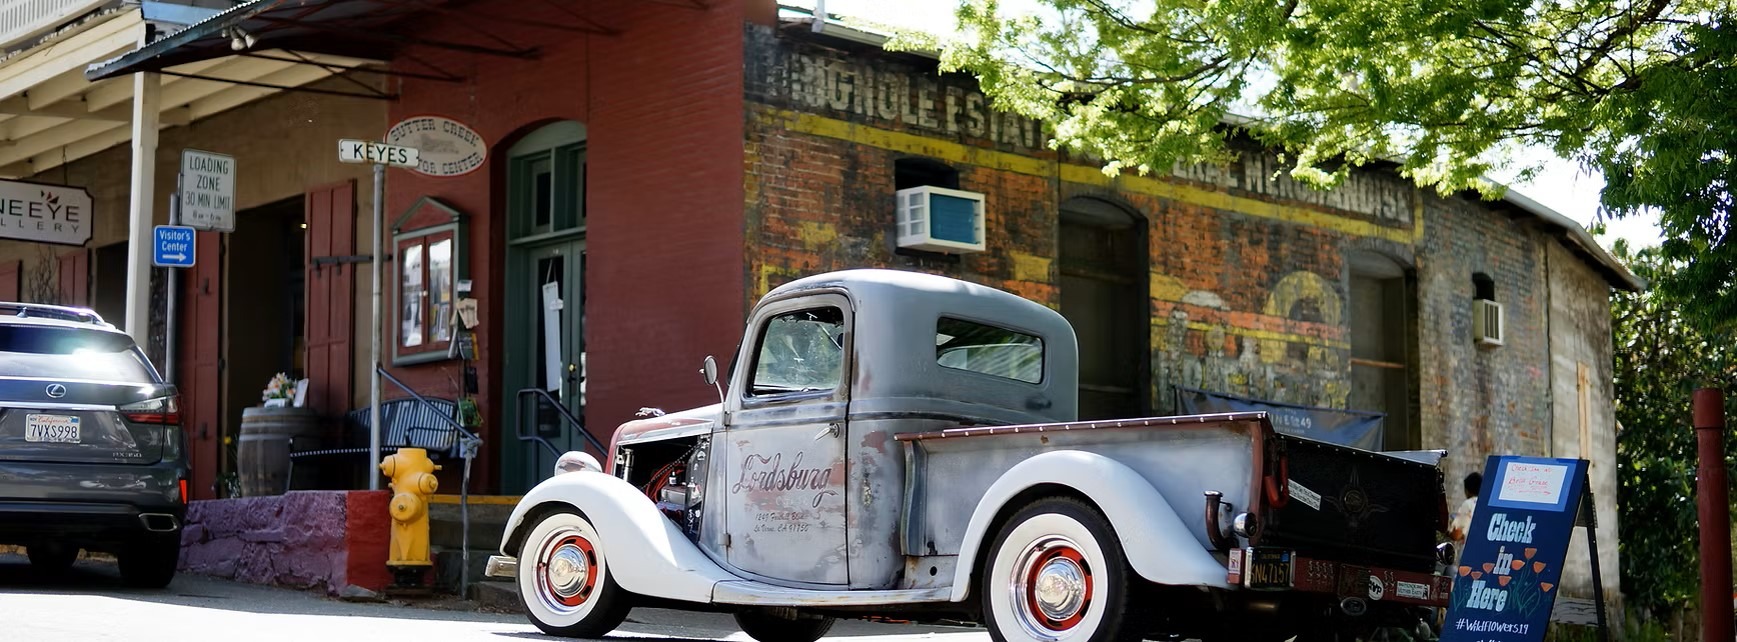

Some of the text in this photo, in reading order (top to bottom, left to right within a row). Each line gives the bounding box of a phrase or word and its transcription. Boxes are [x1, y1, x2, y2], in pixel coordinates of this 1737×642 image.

[946, 86, 1045, 149] ESTAT
[390, 118, 480, 147] SUTTER CREEK
[353, 143, 408, 164] KEYES
[442, 152, 483, 174] CENTER
[189, 155, 229, 175] LOADING
[196, 174, 220, 191] ZONE
[185, 191, 230, 211] 30 MIN LIMIT
[160, 230, 191, 241] Visitor's
[161, 241, 188, 252] Center
[30, 424, 78, 439] 7VXS998
[732, 451, 839, 508] Lordsburg
[1487, 513, 1537, 544] Check
[1493, 545, 1514, 575] in
[1466, 580, 1508, 612] Here
